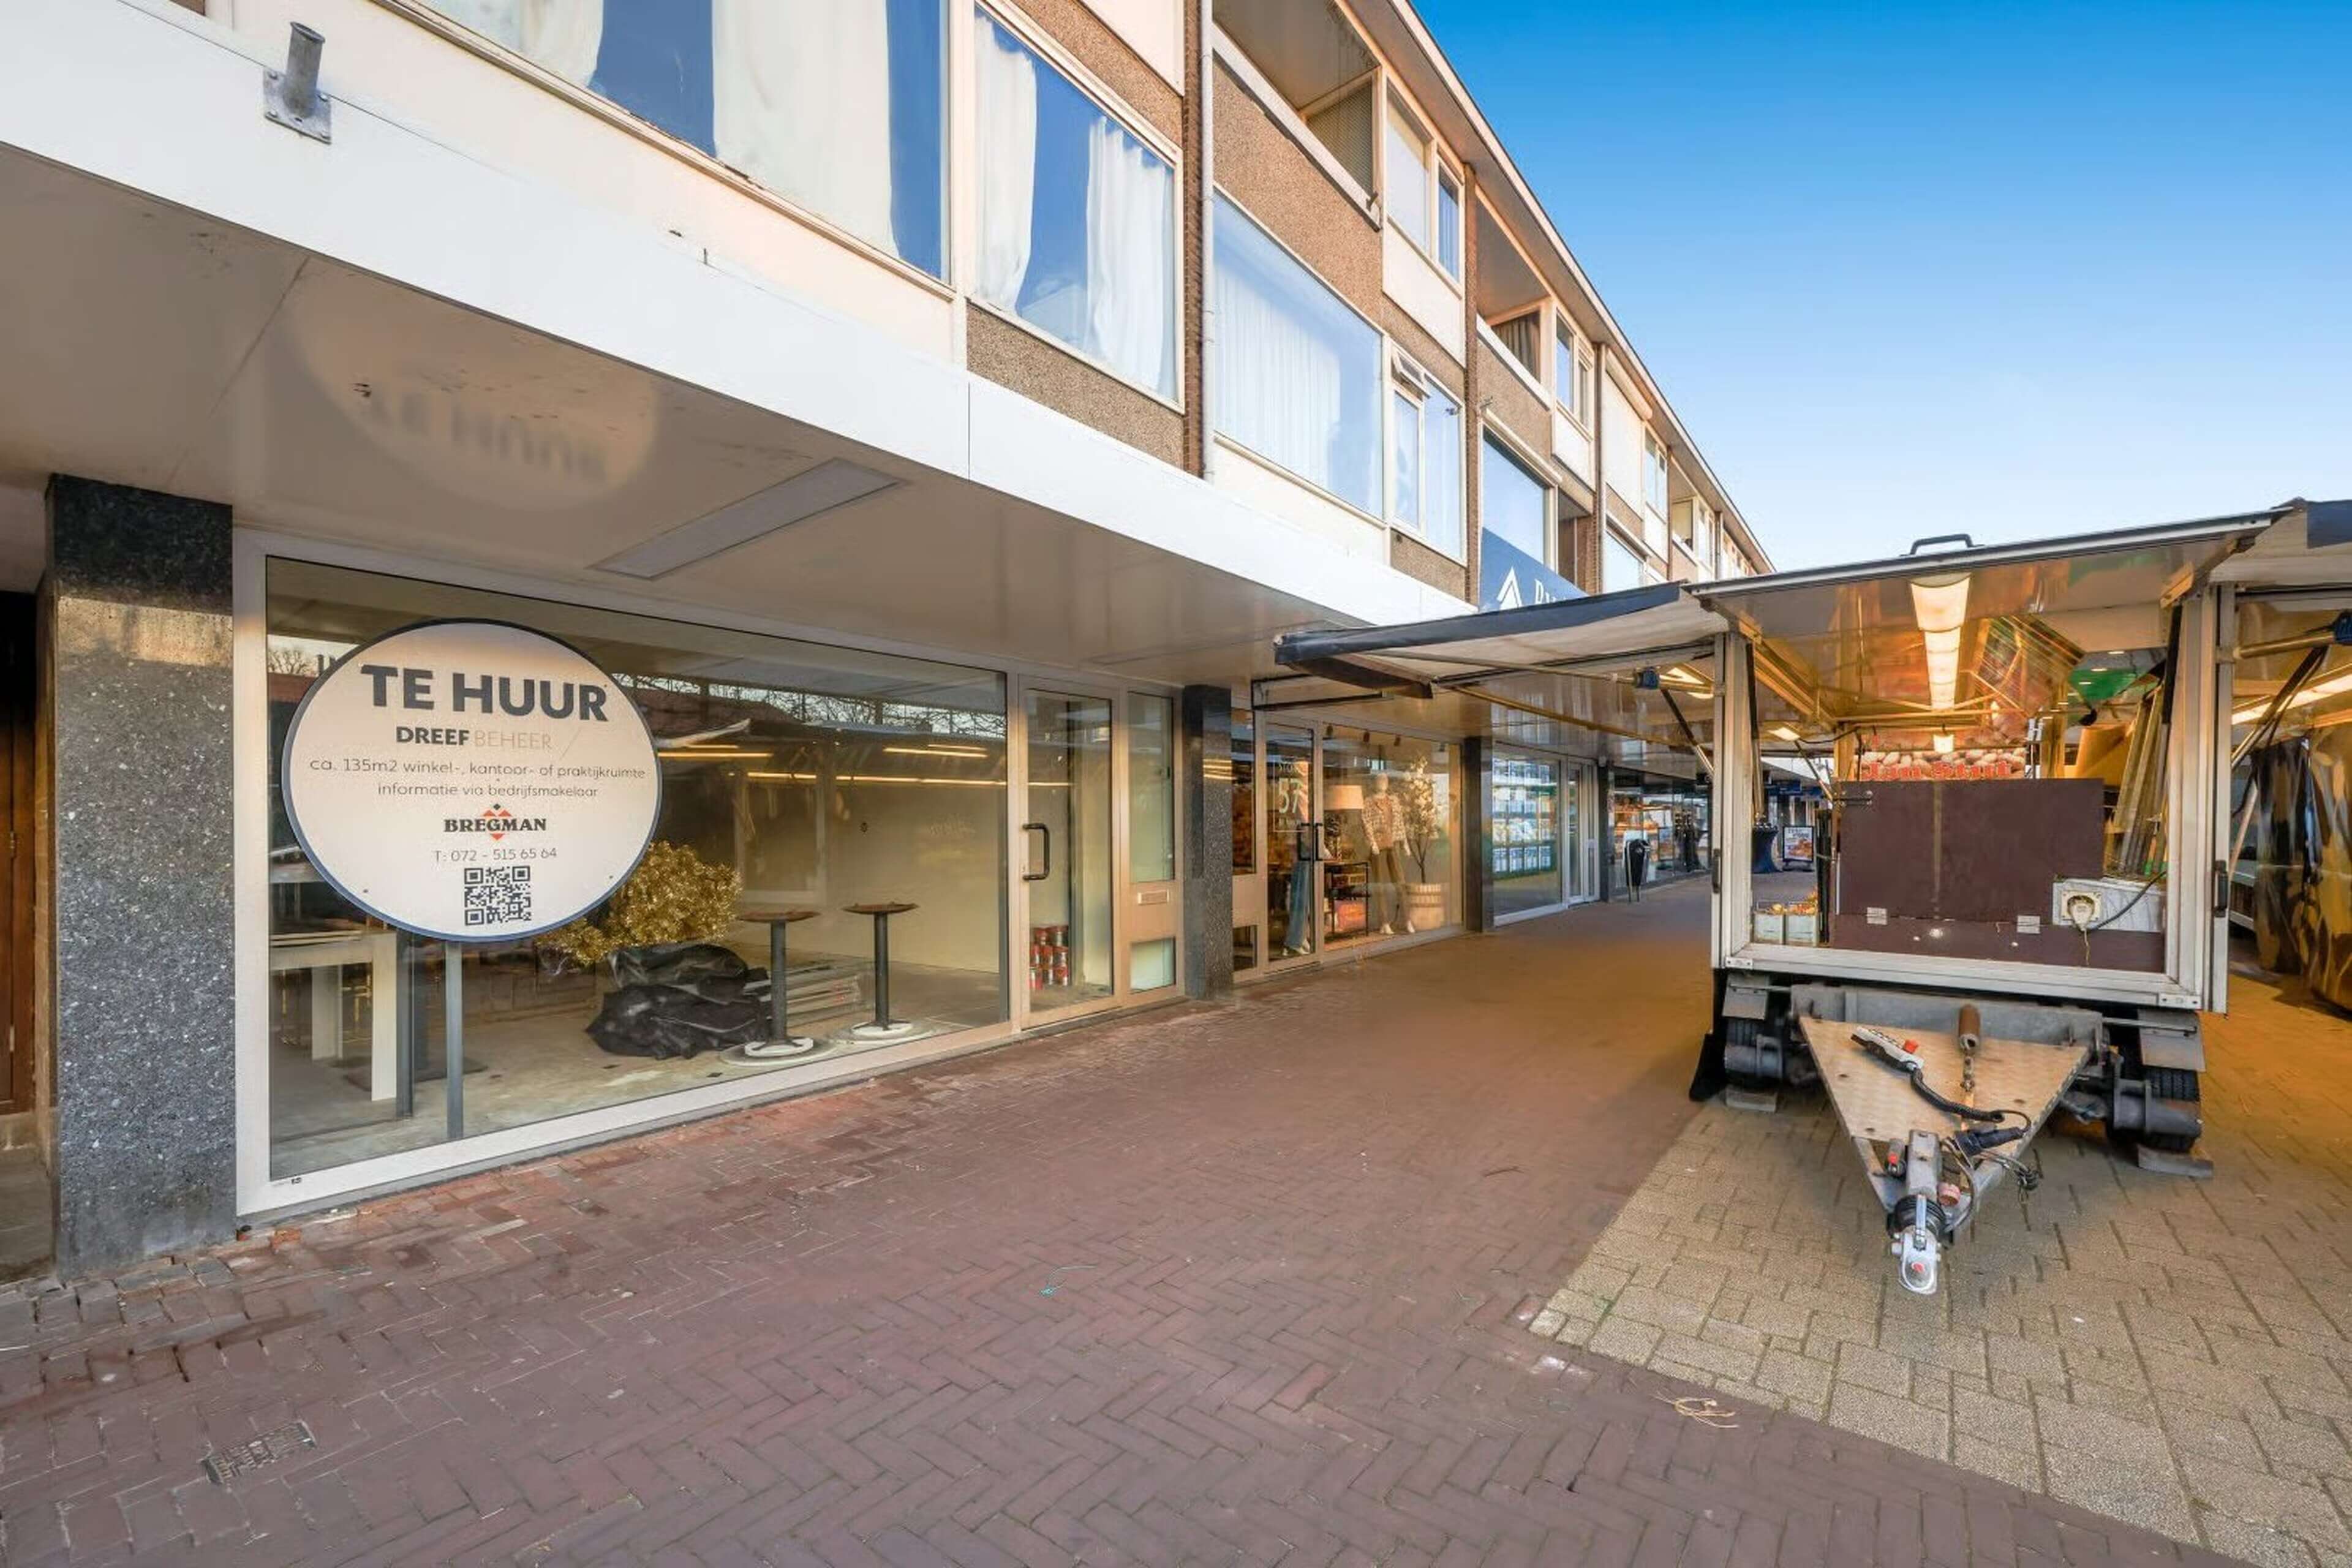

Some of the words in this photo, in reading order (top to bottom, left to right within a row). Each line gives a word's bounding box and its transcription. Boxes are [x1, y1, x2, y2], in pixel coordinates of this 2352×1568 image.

[361, 665, 434, 710] TE
[453, 673, 608, 722] HUUR
[396, 726, 470, 745] DREEF
[475, 731, 552, 750] BEHEER
[310, 760, 337, 771] ca.
[344, 759, 398, 772] 135m2
[470, 763, 534, 775] kantoor-
[540, 765, 554, 776] of
[557, 765, 646, 780] praktijkruimte
[378, 783, 458, 796] informatie
[462, 786, 483, 796] via
[488, 784, 598, 799] bedrijfsmakelaar
[1278, 777, 1303, 813] 57
[443, 818, 546, 832] BREGMAN
[435, 850, 447, 862] T:
[451, 850, 477, 862] 072
[493, 849, 516, 860] 515
[521, 848, 537, 859] 65
[541, 847, 557, 858] 64
